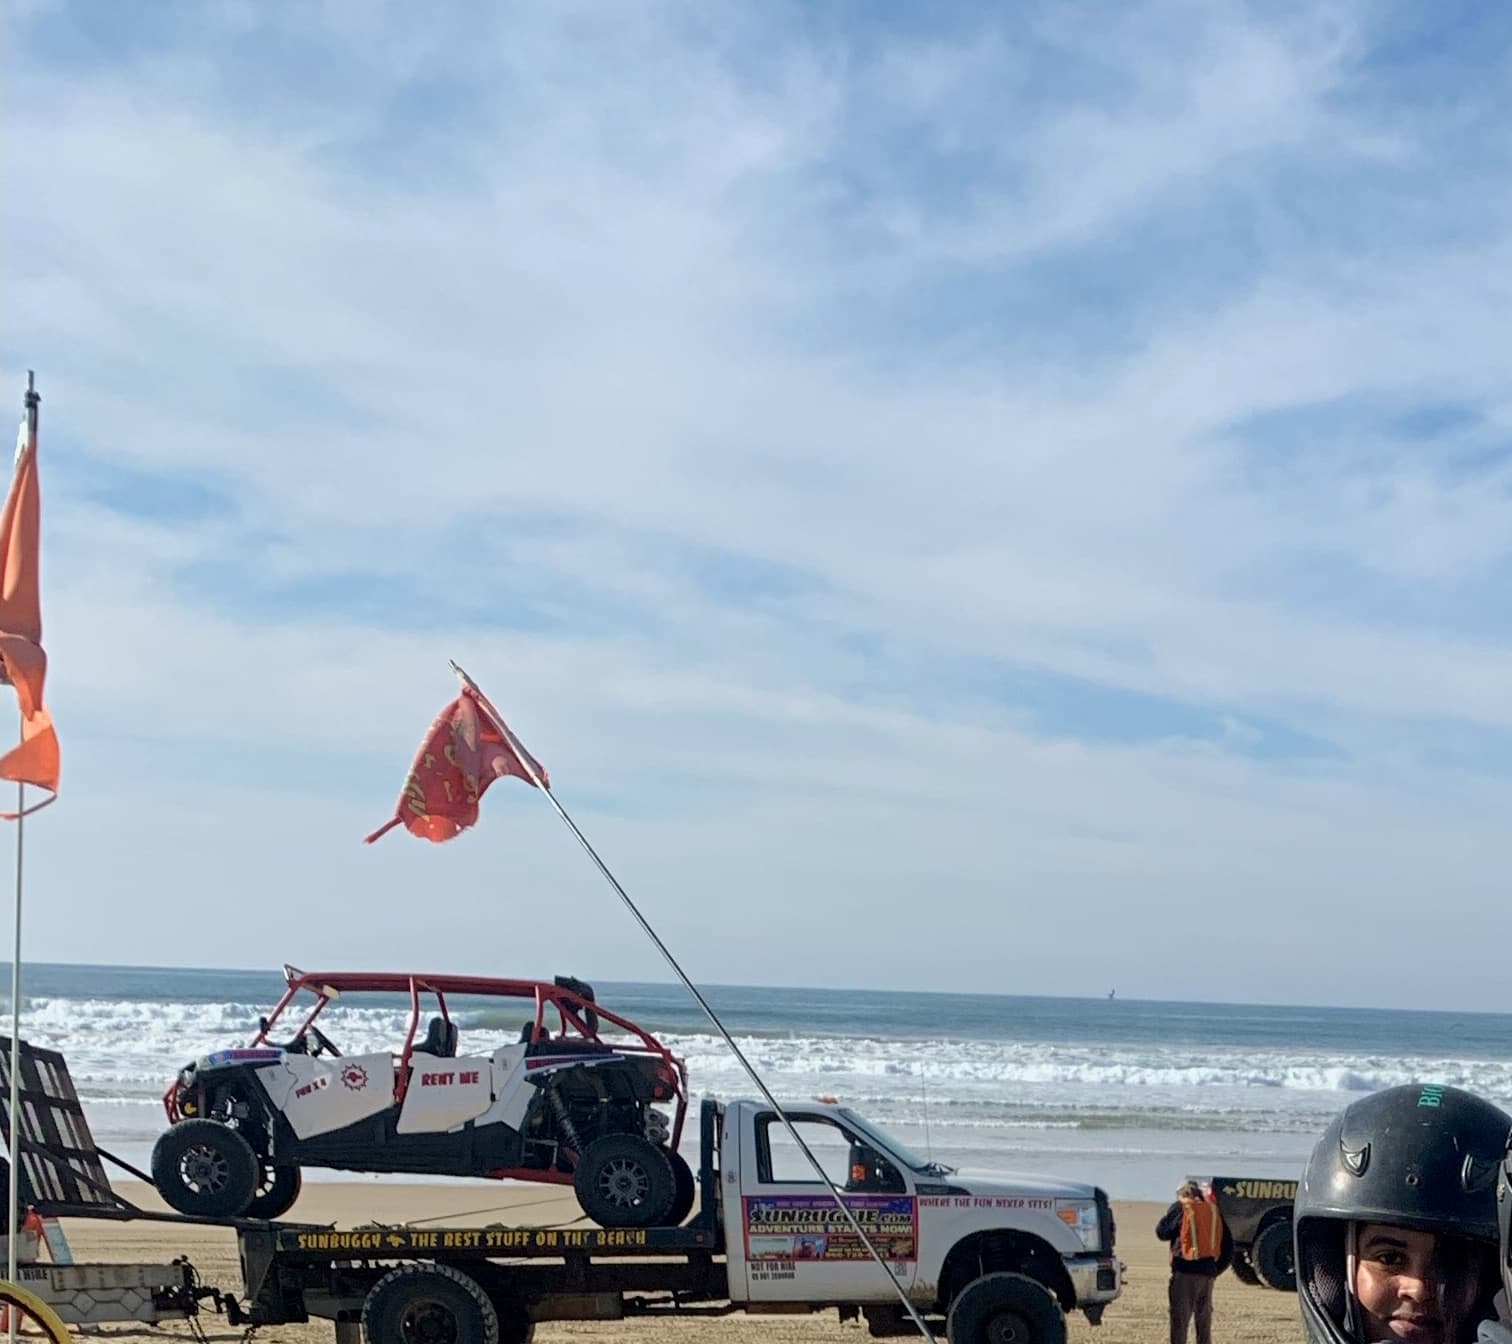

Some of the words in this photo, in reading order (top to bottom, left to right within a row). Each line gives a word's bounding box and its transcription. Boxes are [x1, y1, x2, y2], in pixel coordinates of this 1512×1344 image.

[421, 1073, 455, 1087] RENT
[460, 1072, 479, 1084] ME
[1236, 1181, 1297, 1199] SUNBU
[919, 1198, 950, 1207] WHERE
[954, 1198, 970, 1208] THE
[974, 1198, 992, 1208] FUN
[995, 1199, 1024, 1208] NEVER
[750, 1224, 823, 1233] ADVENTURE
[298, 1232, 381, 1249] SUNBUGGY
[410, 1232, 438, 1247] THE
[444, 1232, 481, 1247] BEST
[486, 1231, 530, 1247] STUFF
[535, 1232, 557, 1246] ON
[597, 1231, 646, 1246] BEACH
